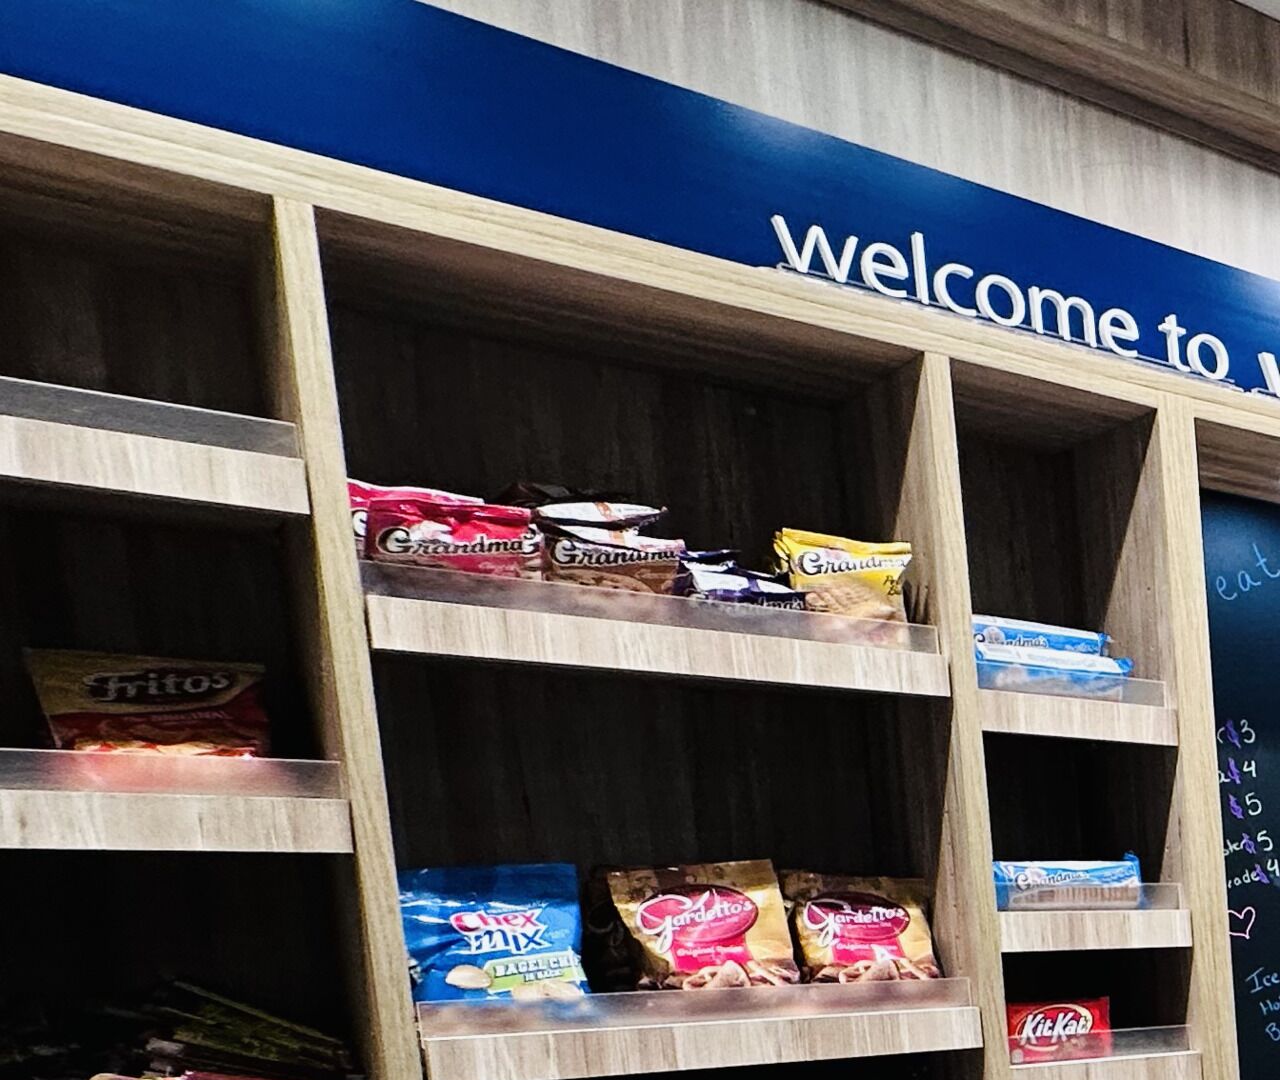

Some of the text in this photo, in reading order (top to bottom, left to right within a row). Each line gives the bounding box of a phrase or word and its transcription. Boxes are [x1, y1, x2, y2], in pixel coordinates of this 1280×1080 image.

[770, 213, 1139, 357] welcome
[1157, 313, 1230, 382] to
[454, 911, 540, 932] Chex
[1245, 967, 1280, 993] Ice
